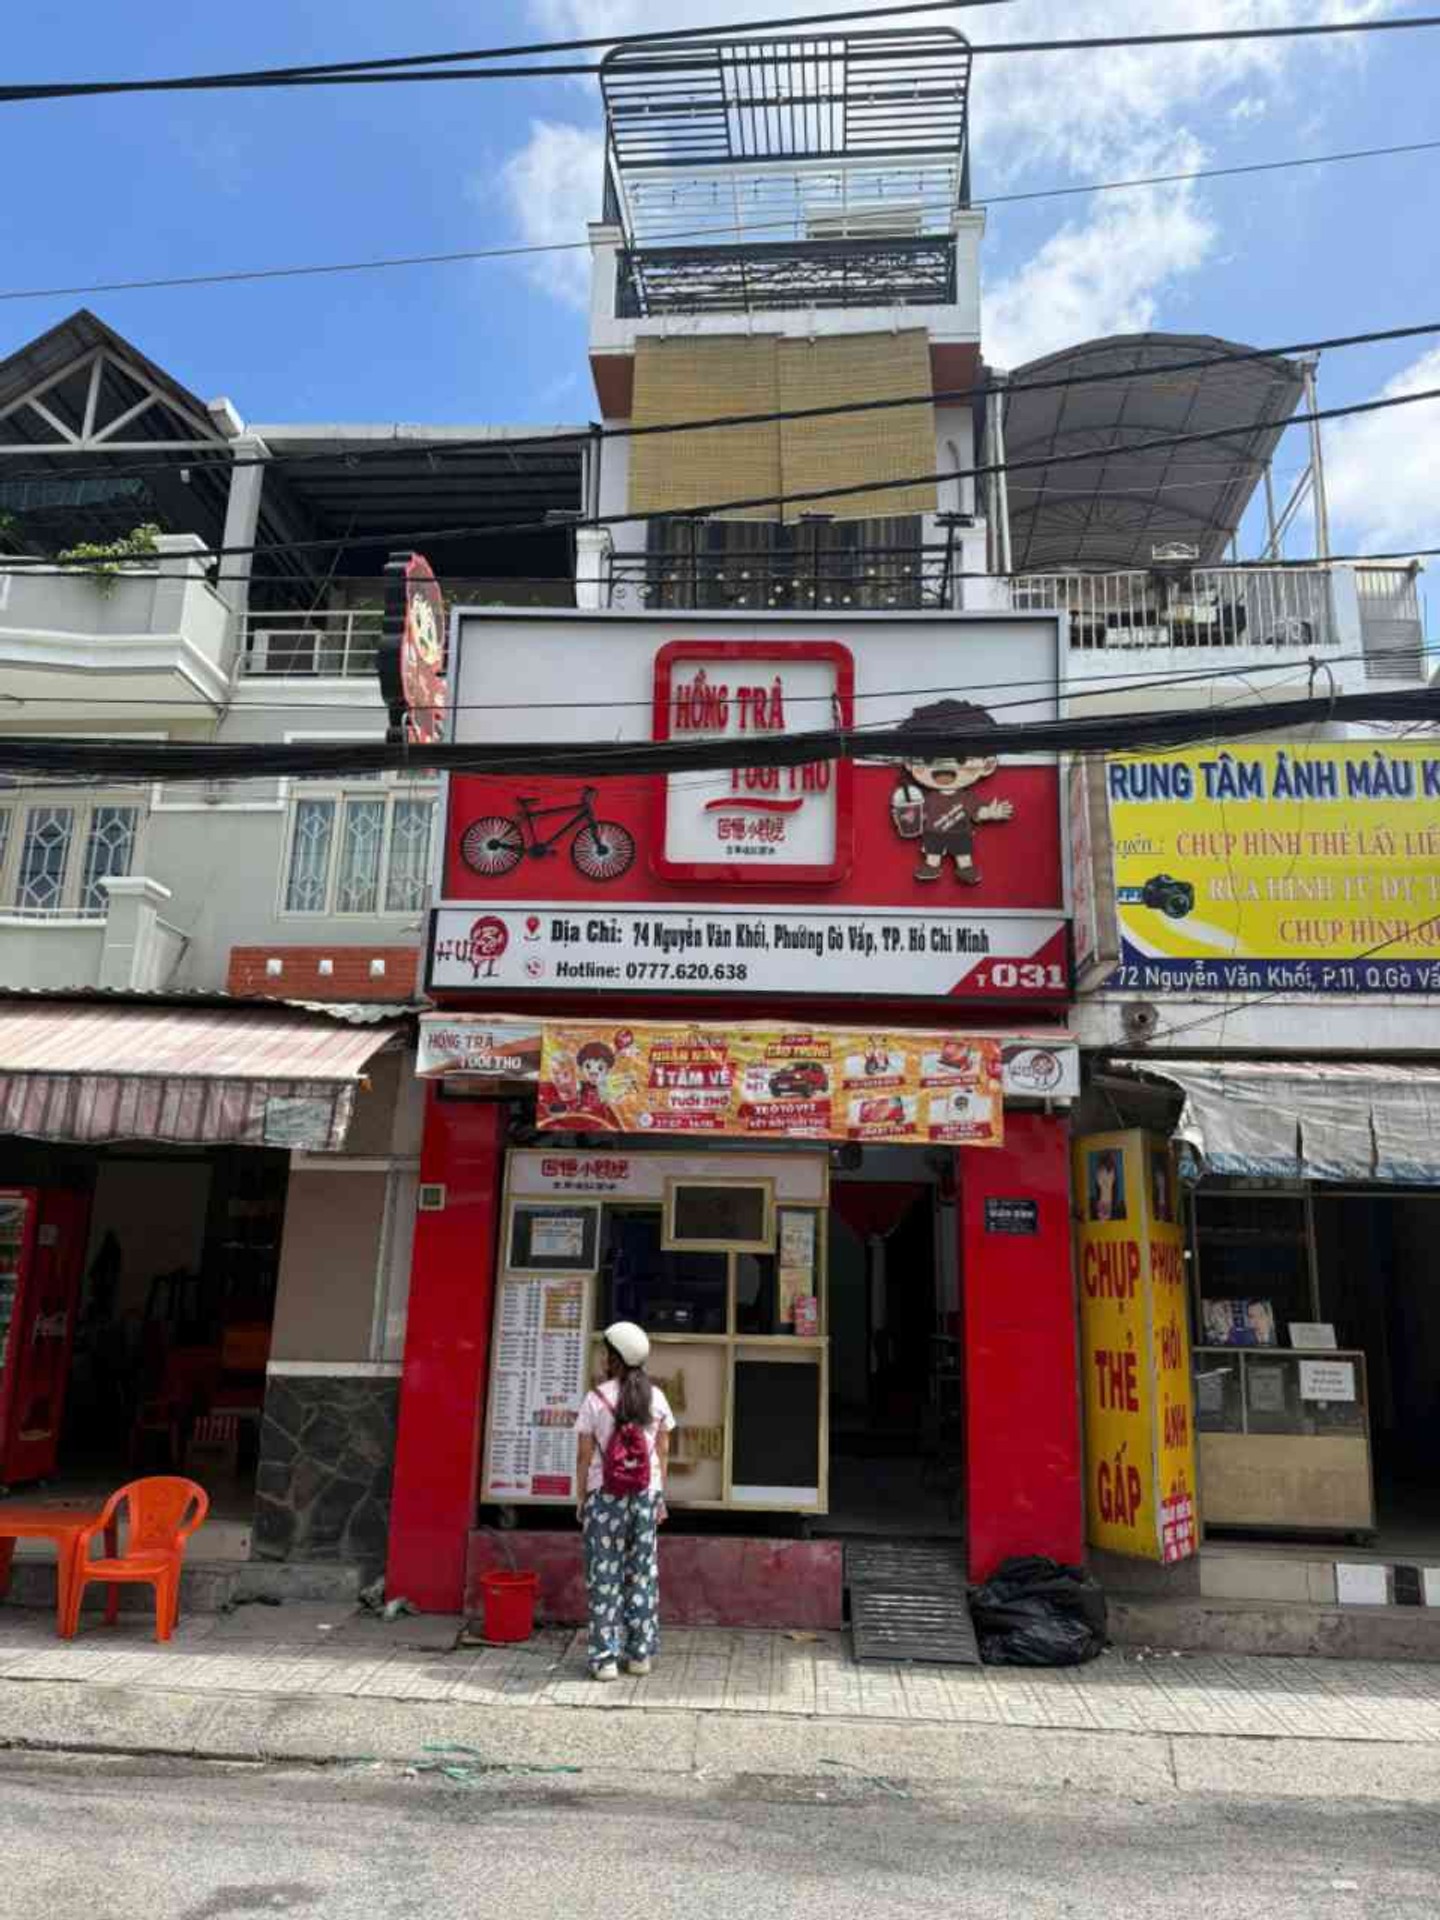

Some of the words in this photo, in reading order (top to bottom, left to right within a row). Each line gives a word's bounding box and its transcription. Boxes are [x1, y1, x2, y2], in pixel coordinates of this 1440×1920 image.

[1199, 751, 1262, 798] TÂM
[1272, 750, 1337, 797] ẢNH
[1345, 750, 1413, 797] MÀU
[633, 922, 649, 947] 74
[956, 928, 990, 953] Minh
[556, 961, 621, 979] Hotline:
[625, 962, 748, 980] 0777.620.638
[1145, 960, 1219, 992] Nguyễn
[1224, 964, 1261, 987] Văn
[1085, 1241, 1140, 1314] CHỤP
[1094, 1331, 1139, 1413] THẺ
